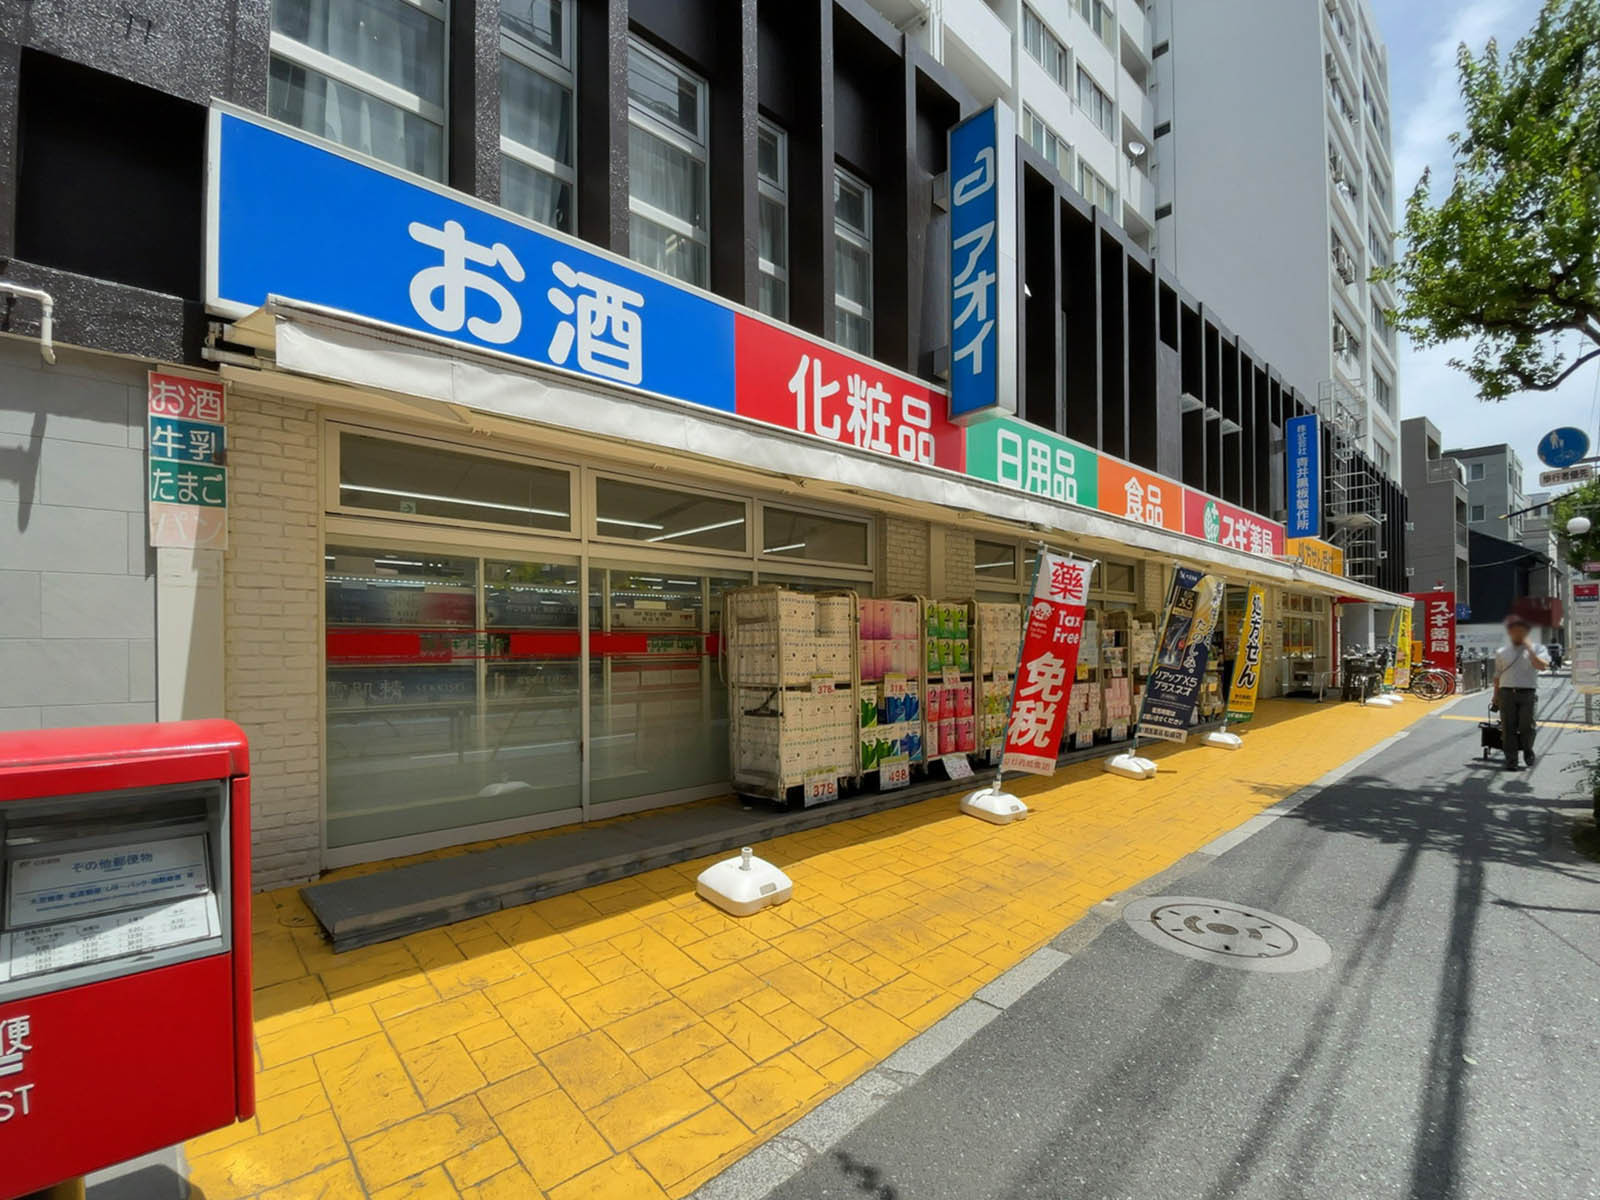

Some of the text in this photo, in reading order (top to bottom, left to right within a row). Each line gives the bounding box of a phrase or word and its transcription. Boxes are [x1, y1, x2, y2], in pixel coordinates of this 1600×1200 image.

[408, 219, 645, 386] お酒
[953, 220, 996, 375] アオイ
[151, 380, 221, 421] お酒
[788, 353, 936, 467] 化粧品
[151, 424, 216, 461] 牛乳
[151, 468, 224, 505] たまご
[996, 427, 1078, 505] 日用品
[1543, 469, 1590, 484] 歩行者優先
[1123, 476, 1164, 528] 食品
[152, 511, 224, 546] パン
[1222, 515, 1273, 556] スギ薬局
[1049, 561, 1085, 600] 藥
[1052, 627, 1080, 645] Free
[1058, 610, 1081, 627] Tax
[1430, 600, 1455, 653] スギ薬局
[1236, 595, 1262, 690] 処方せん
[1008, 651, 1067, 748] 免税
[1154, 680, 1193, 697] プラスネオ
[813, 783, 834, 798] 378
